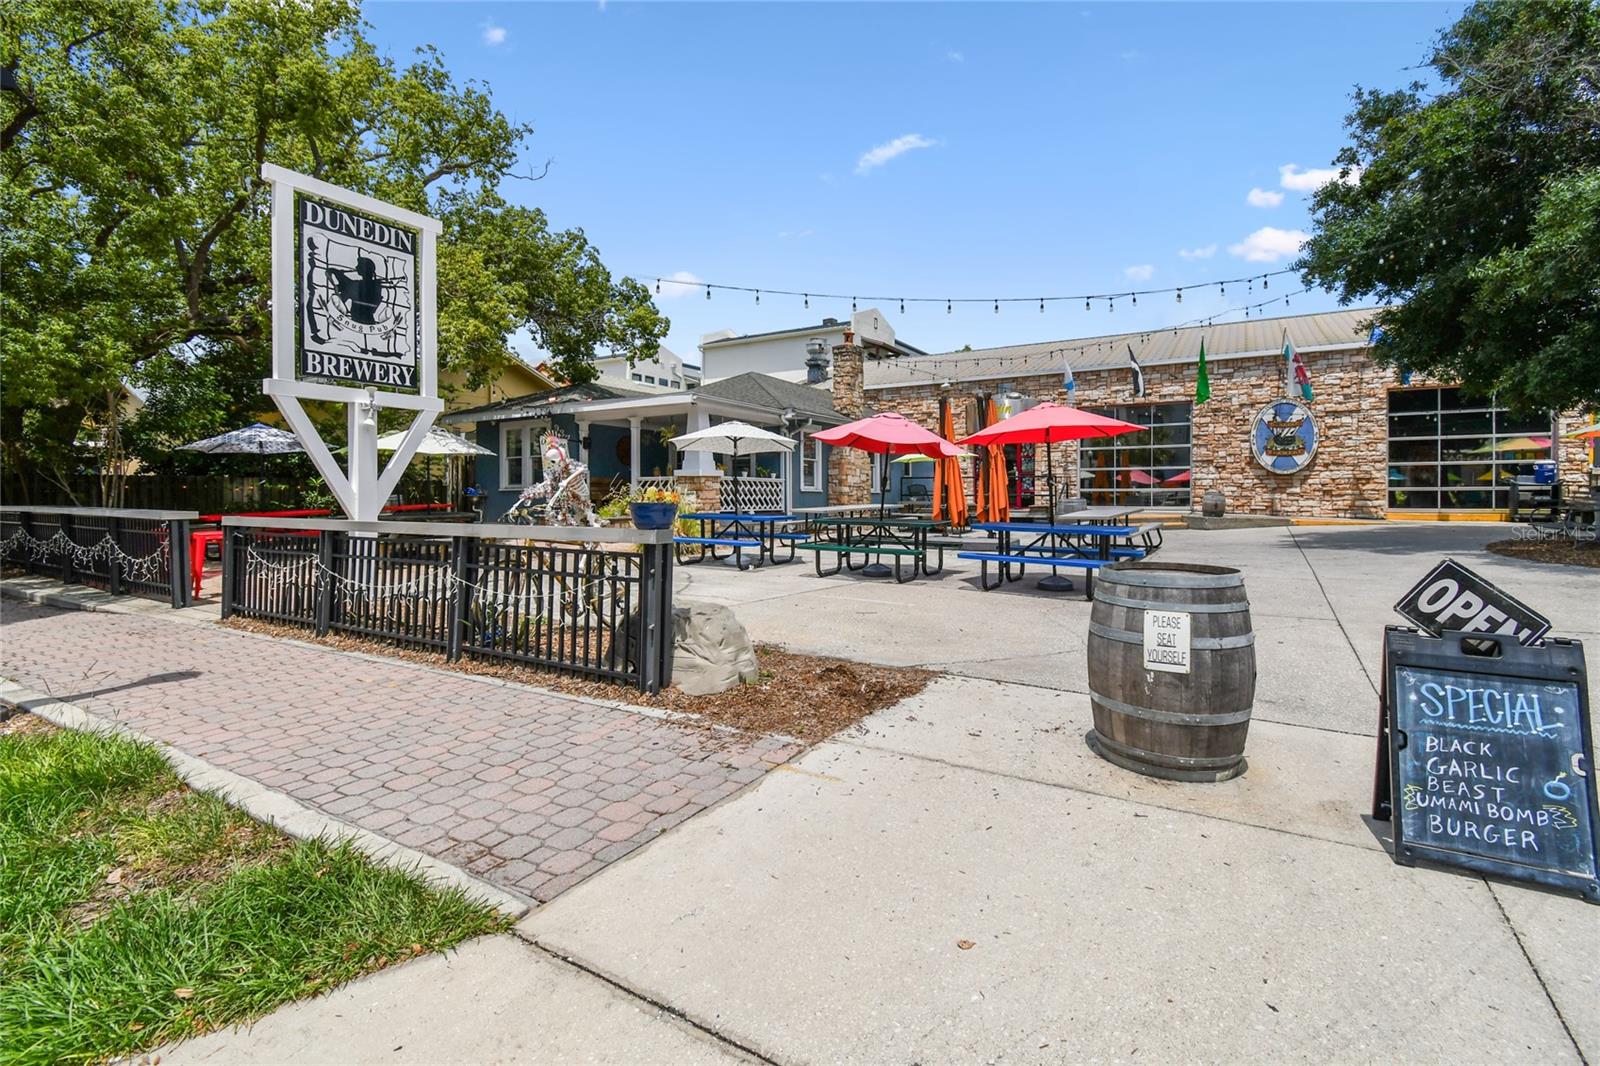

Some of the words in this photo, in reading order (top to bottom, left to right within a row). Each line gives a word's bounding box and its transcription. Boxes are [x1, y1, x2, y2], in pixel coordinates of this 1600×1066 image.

[304, 201, 413, 252] DUNEDIN
[337, 314, 364, 333] Snug
[369, 324, 389, 333] Pub
[305, 351, 414, 386] BREWERY
[1152, 615, 1181, 629] PLEASE
[1156, 632, 1177, 646] SEAT
[1147, 648, 1187, 664] YOURSELF
[1420, 682, 1565, 734] SPECIAL
[1425, 736, 1494, 757] BLACK
[1426, 756, 1520, 784] GARLIC
[1427, 776, 1505, 803] BEAST
[1416, 791, 1480, 815] UMAMI
[1487, 803, 1549, 827] BOMB
[1429, 814, 1539, 852] BURGER
